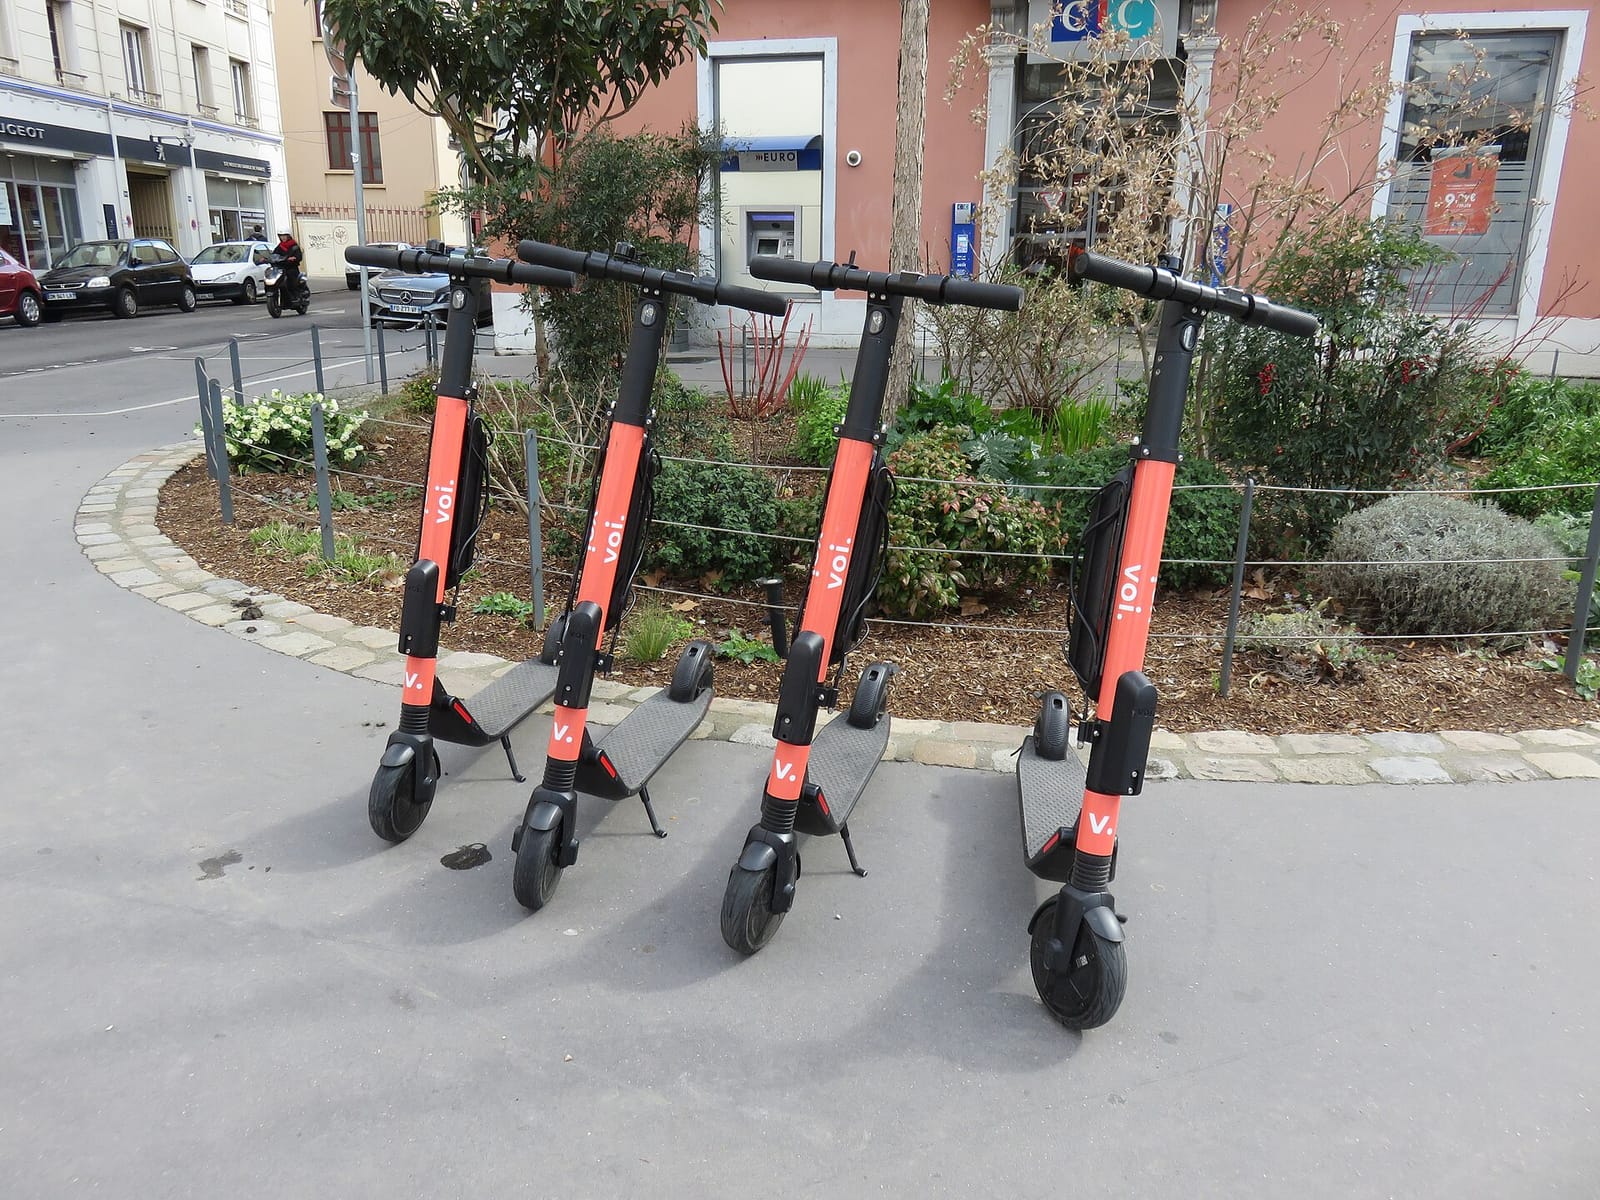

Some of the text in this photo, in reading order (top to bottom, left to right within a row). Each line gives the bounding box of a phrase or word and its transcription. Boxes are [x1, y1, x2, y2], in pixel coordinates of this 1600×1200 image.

[763, 152, 796, 162] EURO
[435, 479, 455, 524] voi.
[603, 515, 625, 563] voi.
[827, 537, 852, 589] voi.
[1116, 564, 1142, 621] voi.
